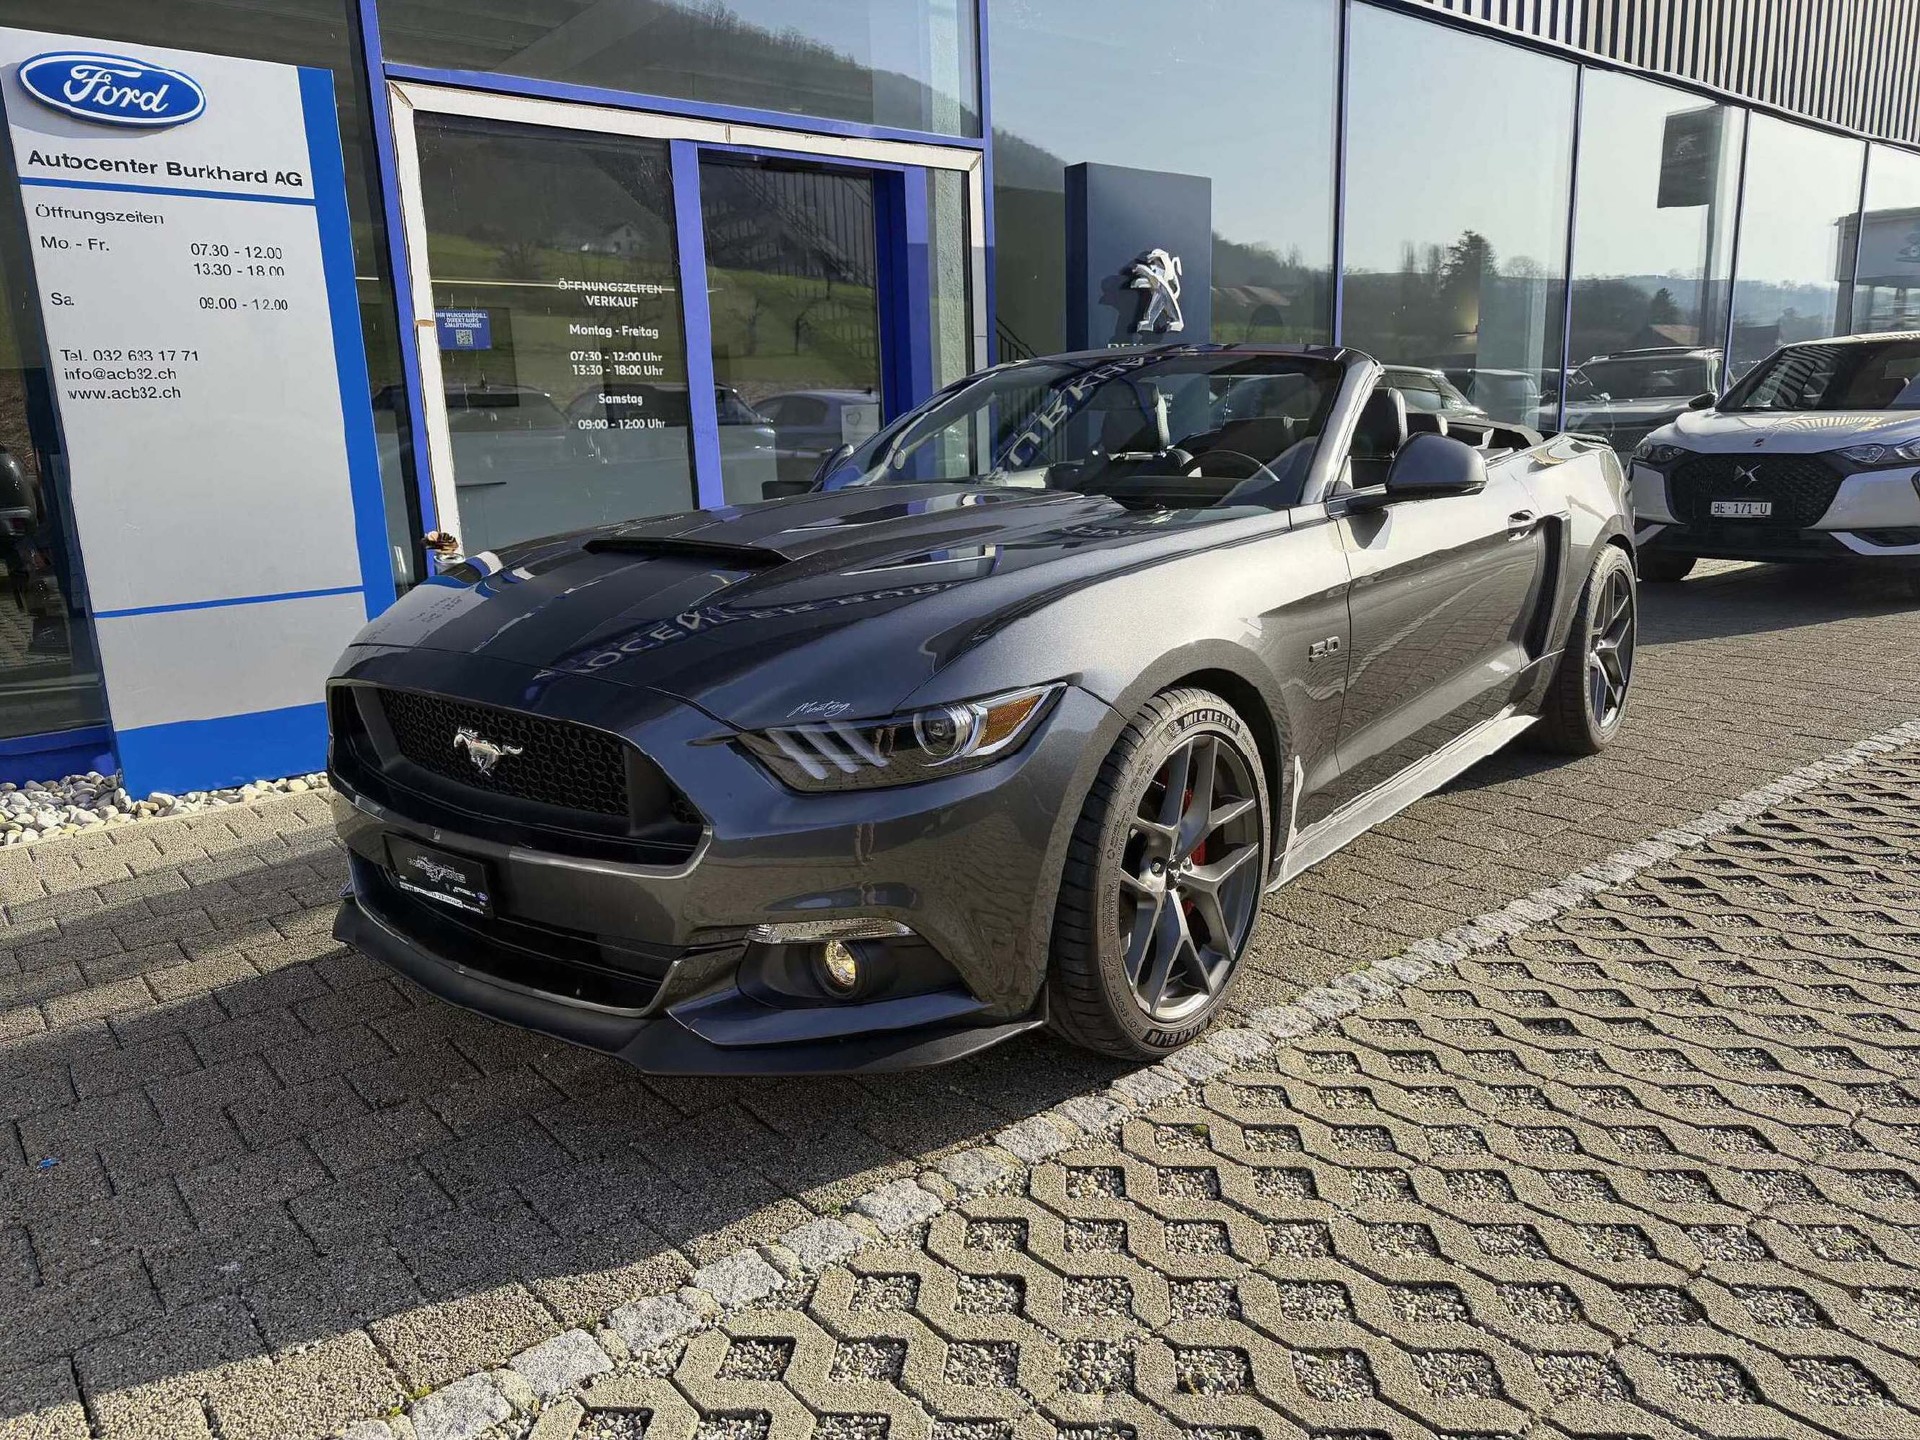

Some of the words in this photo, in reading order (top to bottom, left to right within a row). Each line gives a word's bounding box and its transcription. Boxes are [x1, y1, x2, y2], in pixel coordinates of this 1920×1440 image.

[63, 64, 169, 113] Ford
[28, 150, 158, 175] Autocenter
[166, 161, 268, 184] Burkhard
[274, 171, 303, 186] AG
[88, 238, 110, 251] Fr.
[190, 242, 229, 257] 07.30
[244, 246, 282, 259] 12.00
[193, 262, 232, 276] 13.30
[558, 277, 663, 294] ÖFFNUNGSZEITEN
[199, 296, 237, 310] 09.00
[252, 298, 288, 311] 12.00
[585, 295, 639, 308] VERKAUF
[569, 324, 612, 338] Montag
[621, 325, 659, 339] Freitag
[60, 349, 88, 361] Tel.
[93, 349, 122, 361] 032
[127, 350, 153, 361] 633
[159, 350, 176, 361] 17
[181, 350, 199, 361] 71
[570, 351, 602, 361] 07:30
[613, 351, 641, 361] 12:00
[643, 351, 662, 361] Uhr
[64, 367, 177, 380] info@acb32.ch
[572, 364, 603, 375] 13:30
[614, 364, 641, 375] 18:00
[643, 365, 664, 376] Uhr
[67, 386, 181, 400] www.acb32.ch
[598, 393, 643, 406] Samstag
[578, 419, 609, 429] 09:00
[618, 419, 645, 429] 12:00
[647, 418, 665, 429] Uhr
[1183, 710, 1239, 735] MICHELIN
